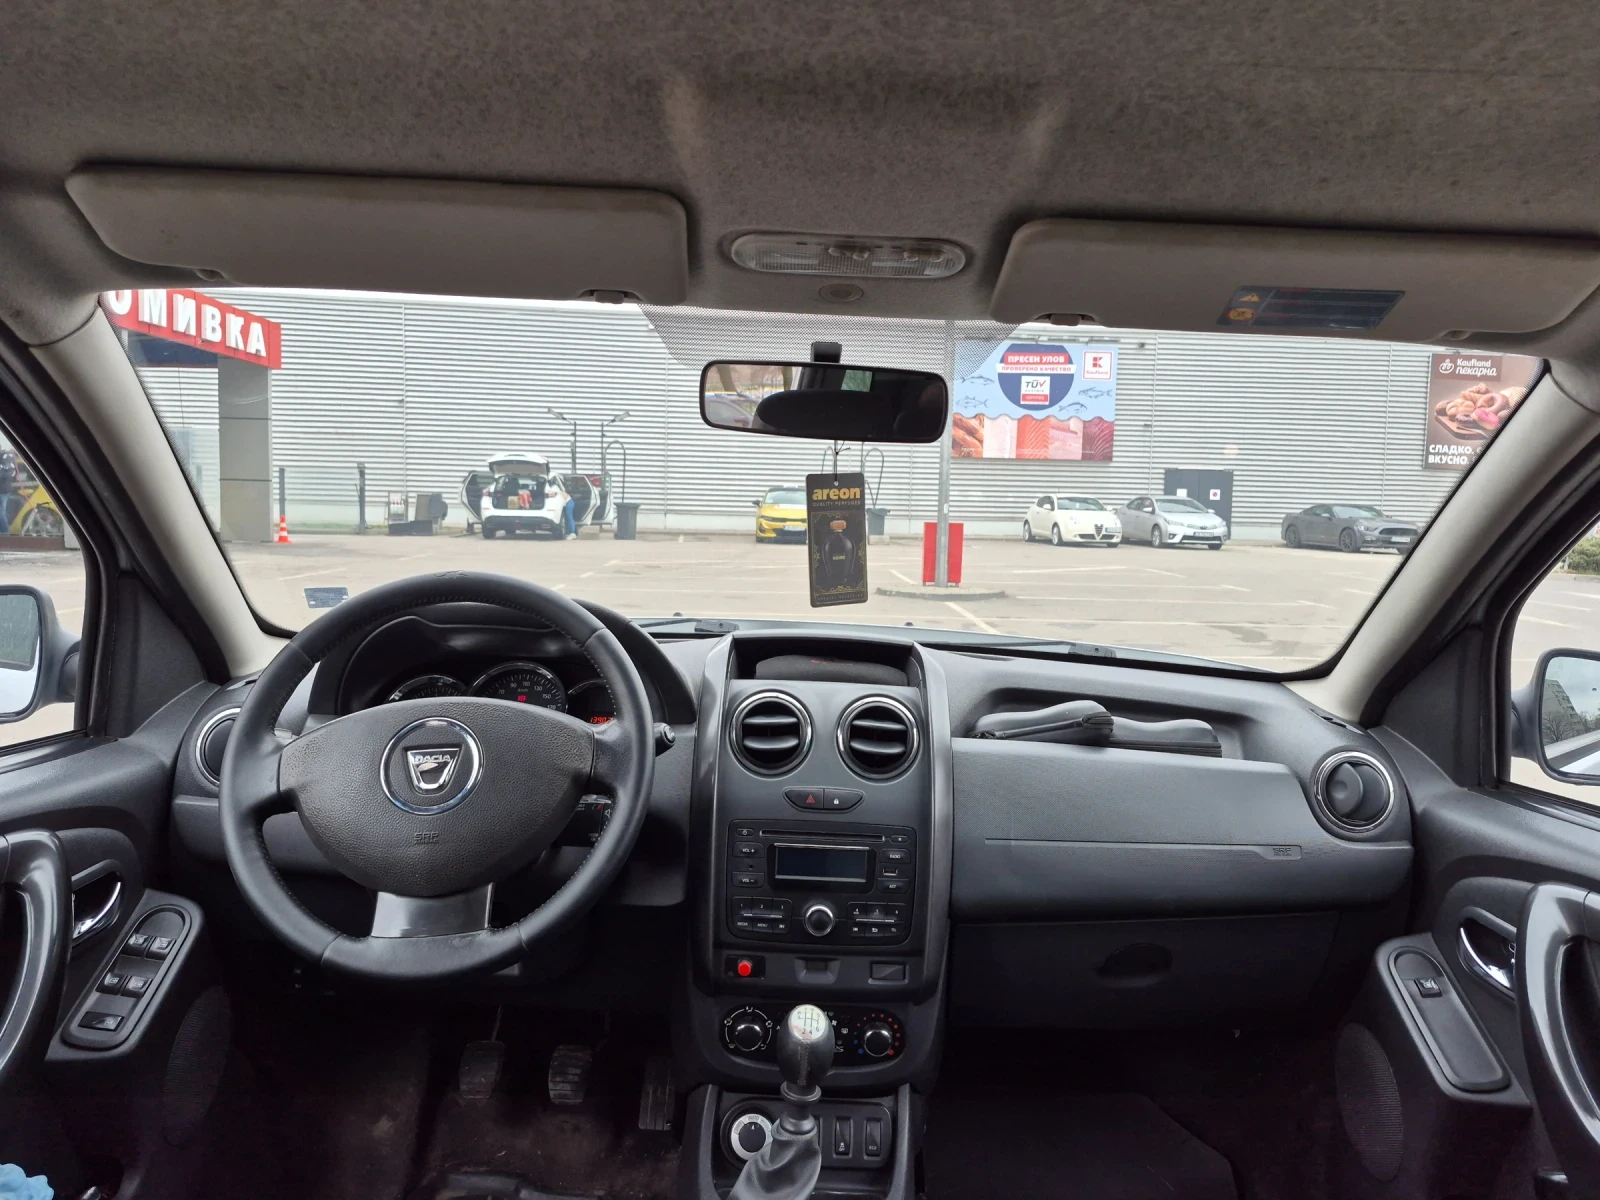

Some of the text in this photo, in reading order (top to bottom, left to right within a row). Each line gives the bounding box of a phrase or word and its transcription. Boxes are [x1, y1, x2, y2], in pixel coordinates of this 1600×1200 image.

[1007, 355, 1065, 363] ПРЕСЕН УЛОВ
[1457, 358, 1491, 367] Kaufland
[1456, 366, 1497, 377] пекарна
[1429, 444, 1474, 455] СЛАДКО.
[812, 487, 860, 500] areon
[414, 755, 451, 763] DACIA
